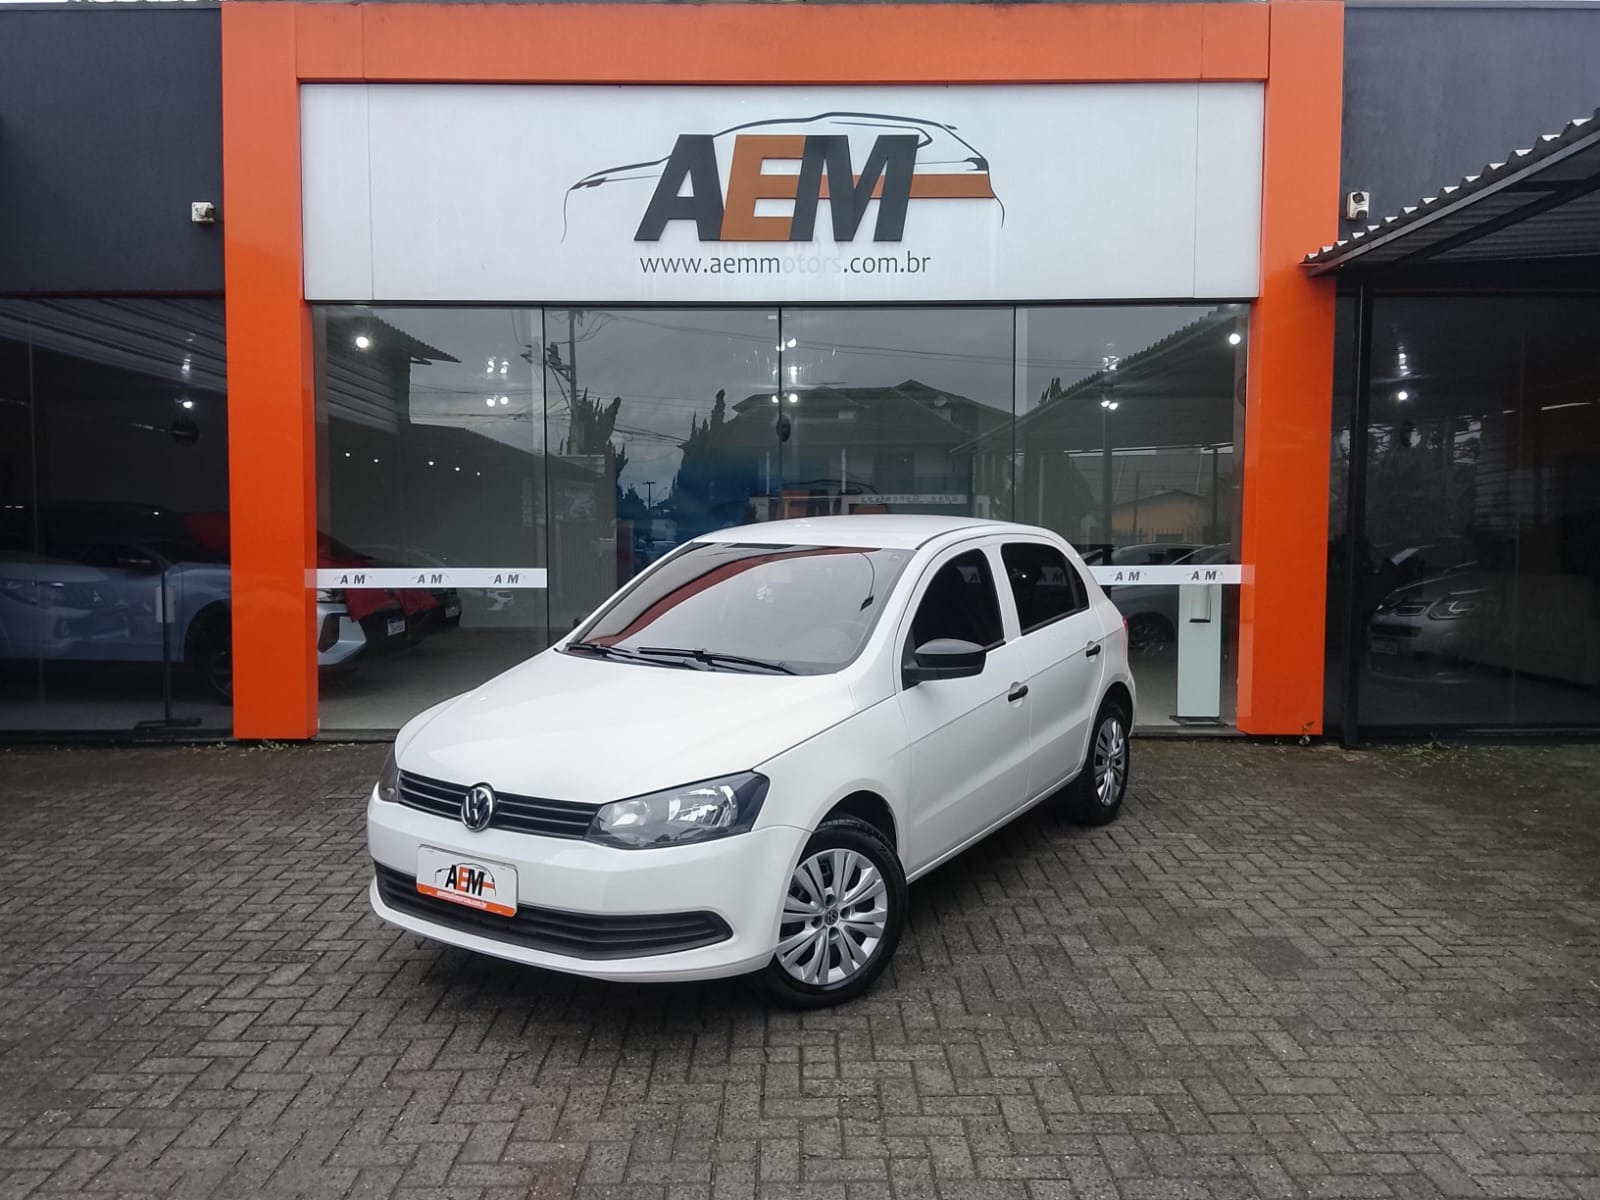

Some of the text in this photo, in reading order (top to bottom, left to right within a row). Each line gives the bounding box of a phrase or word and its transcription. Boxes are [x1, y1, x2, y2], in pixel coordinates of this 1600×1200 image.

[634, 133, 920, 242] AEM
[639, 250, 931, 274] www.aemmotors.com.br
[445, 864, 485, 897] AEM
